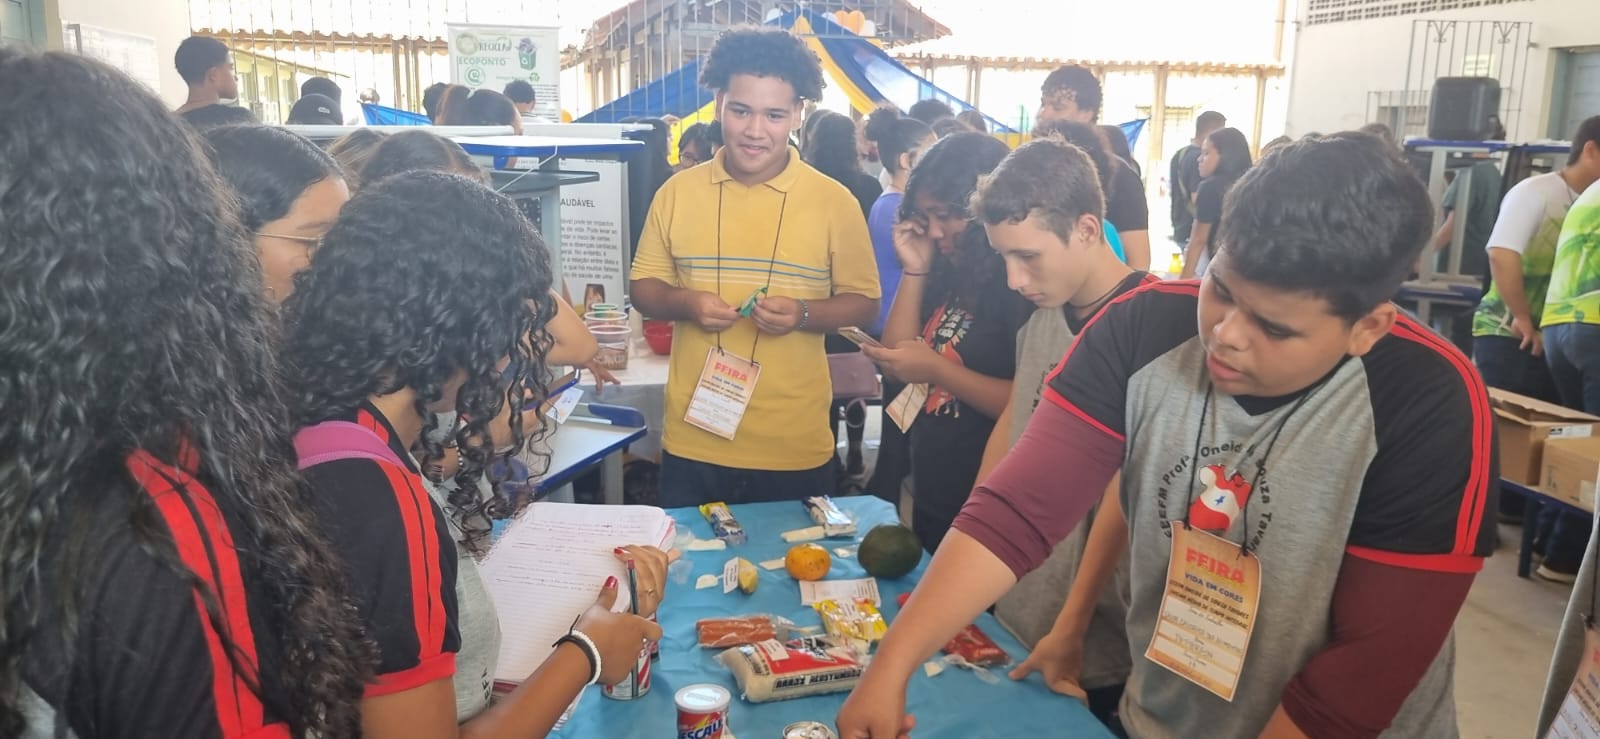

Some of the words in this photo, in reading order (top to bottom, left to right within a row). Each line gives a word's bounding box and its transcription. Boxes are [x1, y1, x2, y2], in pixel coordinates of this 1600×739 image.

[458, 57, 506, 66] ECOPONTO
[560, 197, 595, 207] AUDÁVEL
[714, 362, 748, 381] FEIRA
[1200, 441, 1242, 457] Oneid
[1248, 512, 1272, 551] Tavar
[1186, 547, 1245, 583] FEIRA
[1185, 572, 1203, 586] VIDA
[1206, 581, 1217, 591] EM
[1218, 587, 1243, 603] CORES
